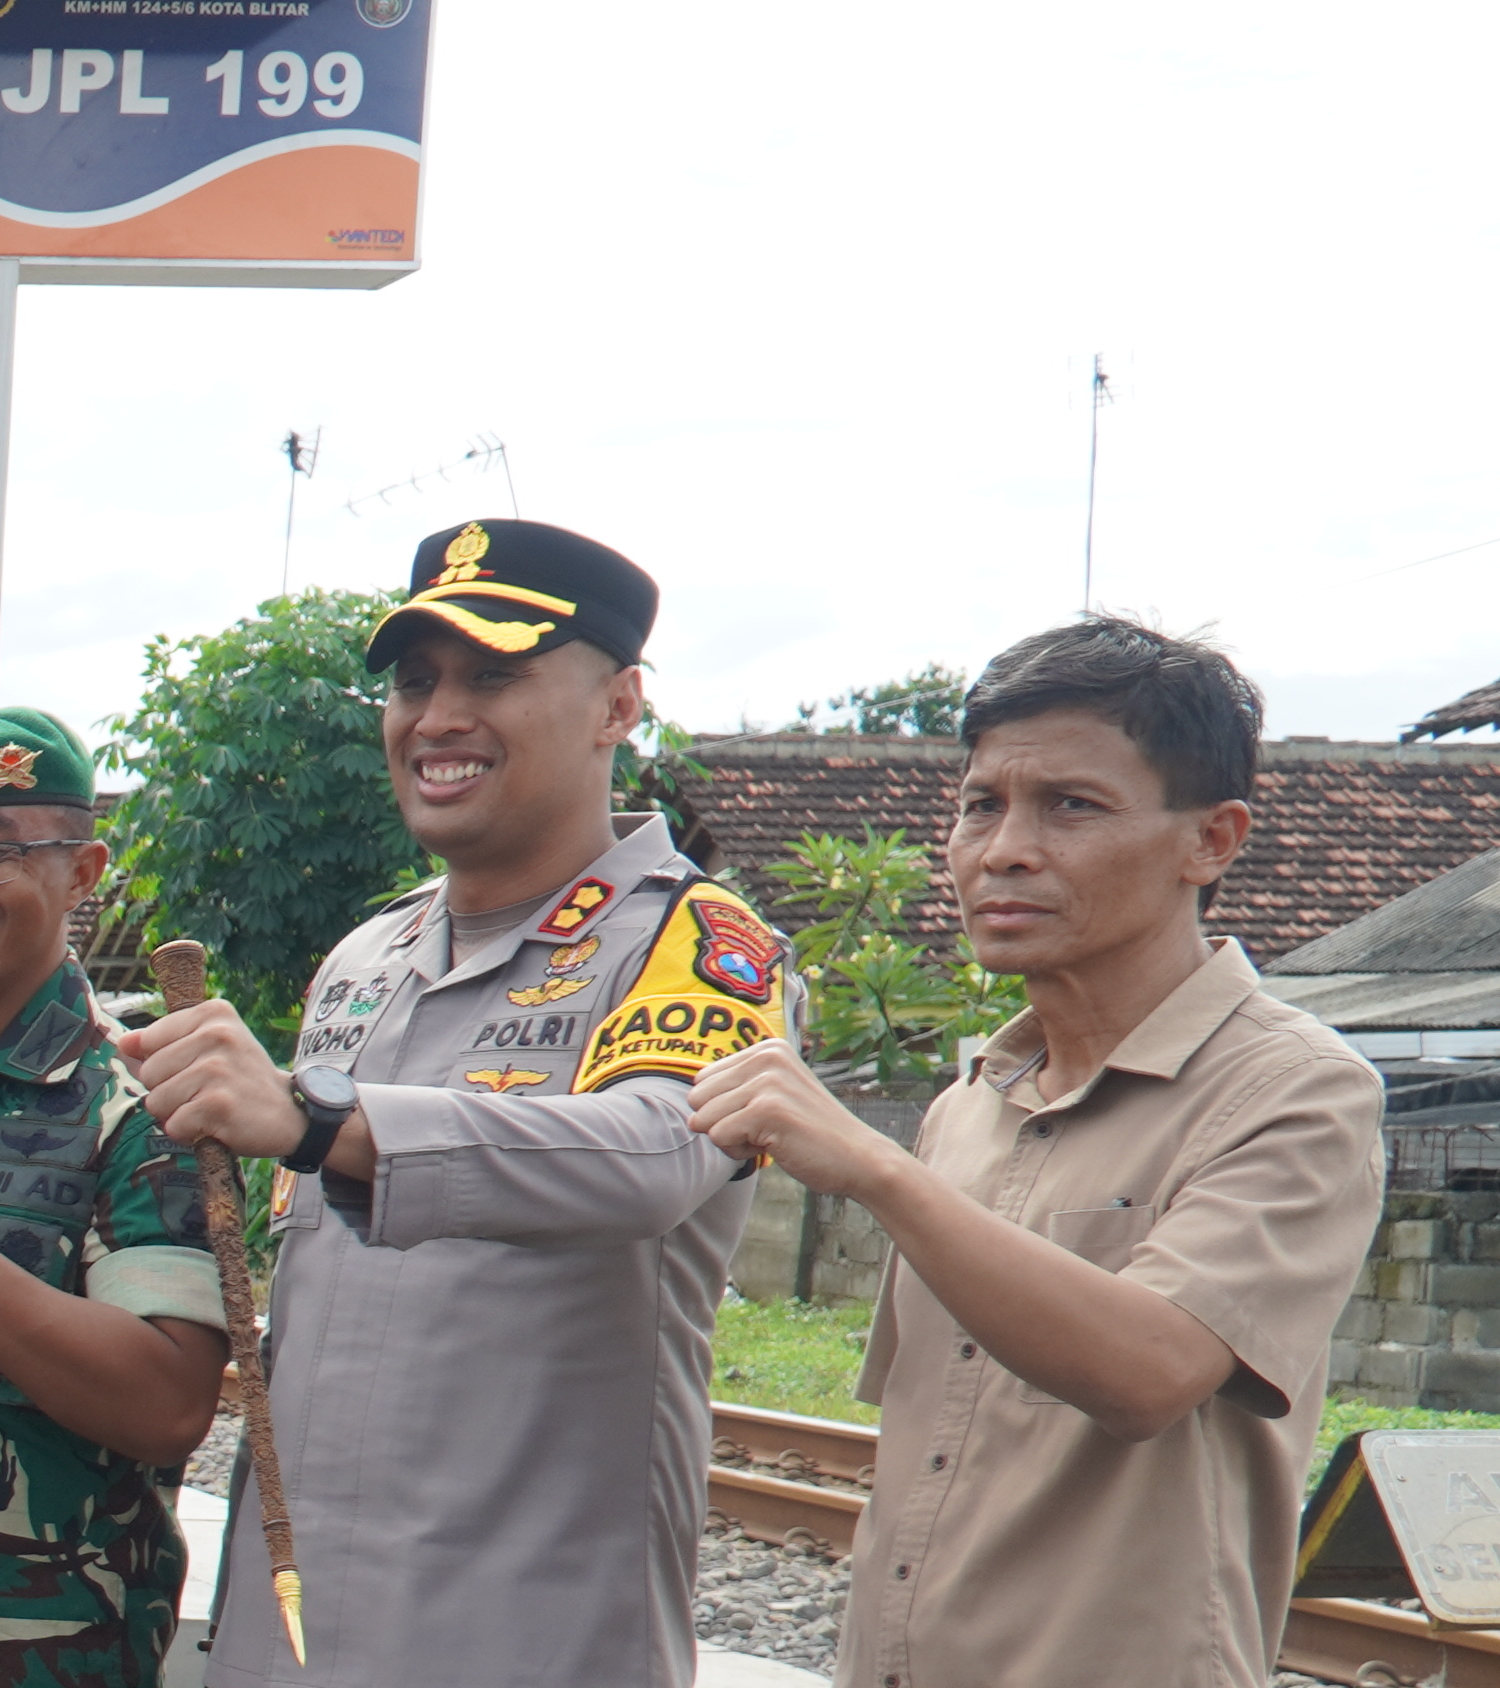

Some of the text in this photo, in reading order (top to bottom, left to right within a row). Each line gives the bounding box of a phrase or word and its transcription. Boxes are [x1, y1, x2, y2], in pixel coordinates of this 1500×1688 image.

[65, 1, 309, 17] KM+HM 124+5/6 KOTA BLITAR
[1, 47, 365, 119] JPL 199
[472, 1015, 576, 1048] POLRI
[619, 1038, 709, 1057] KETUPAT
[25, 1178, 84, 1206] AD
